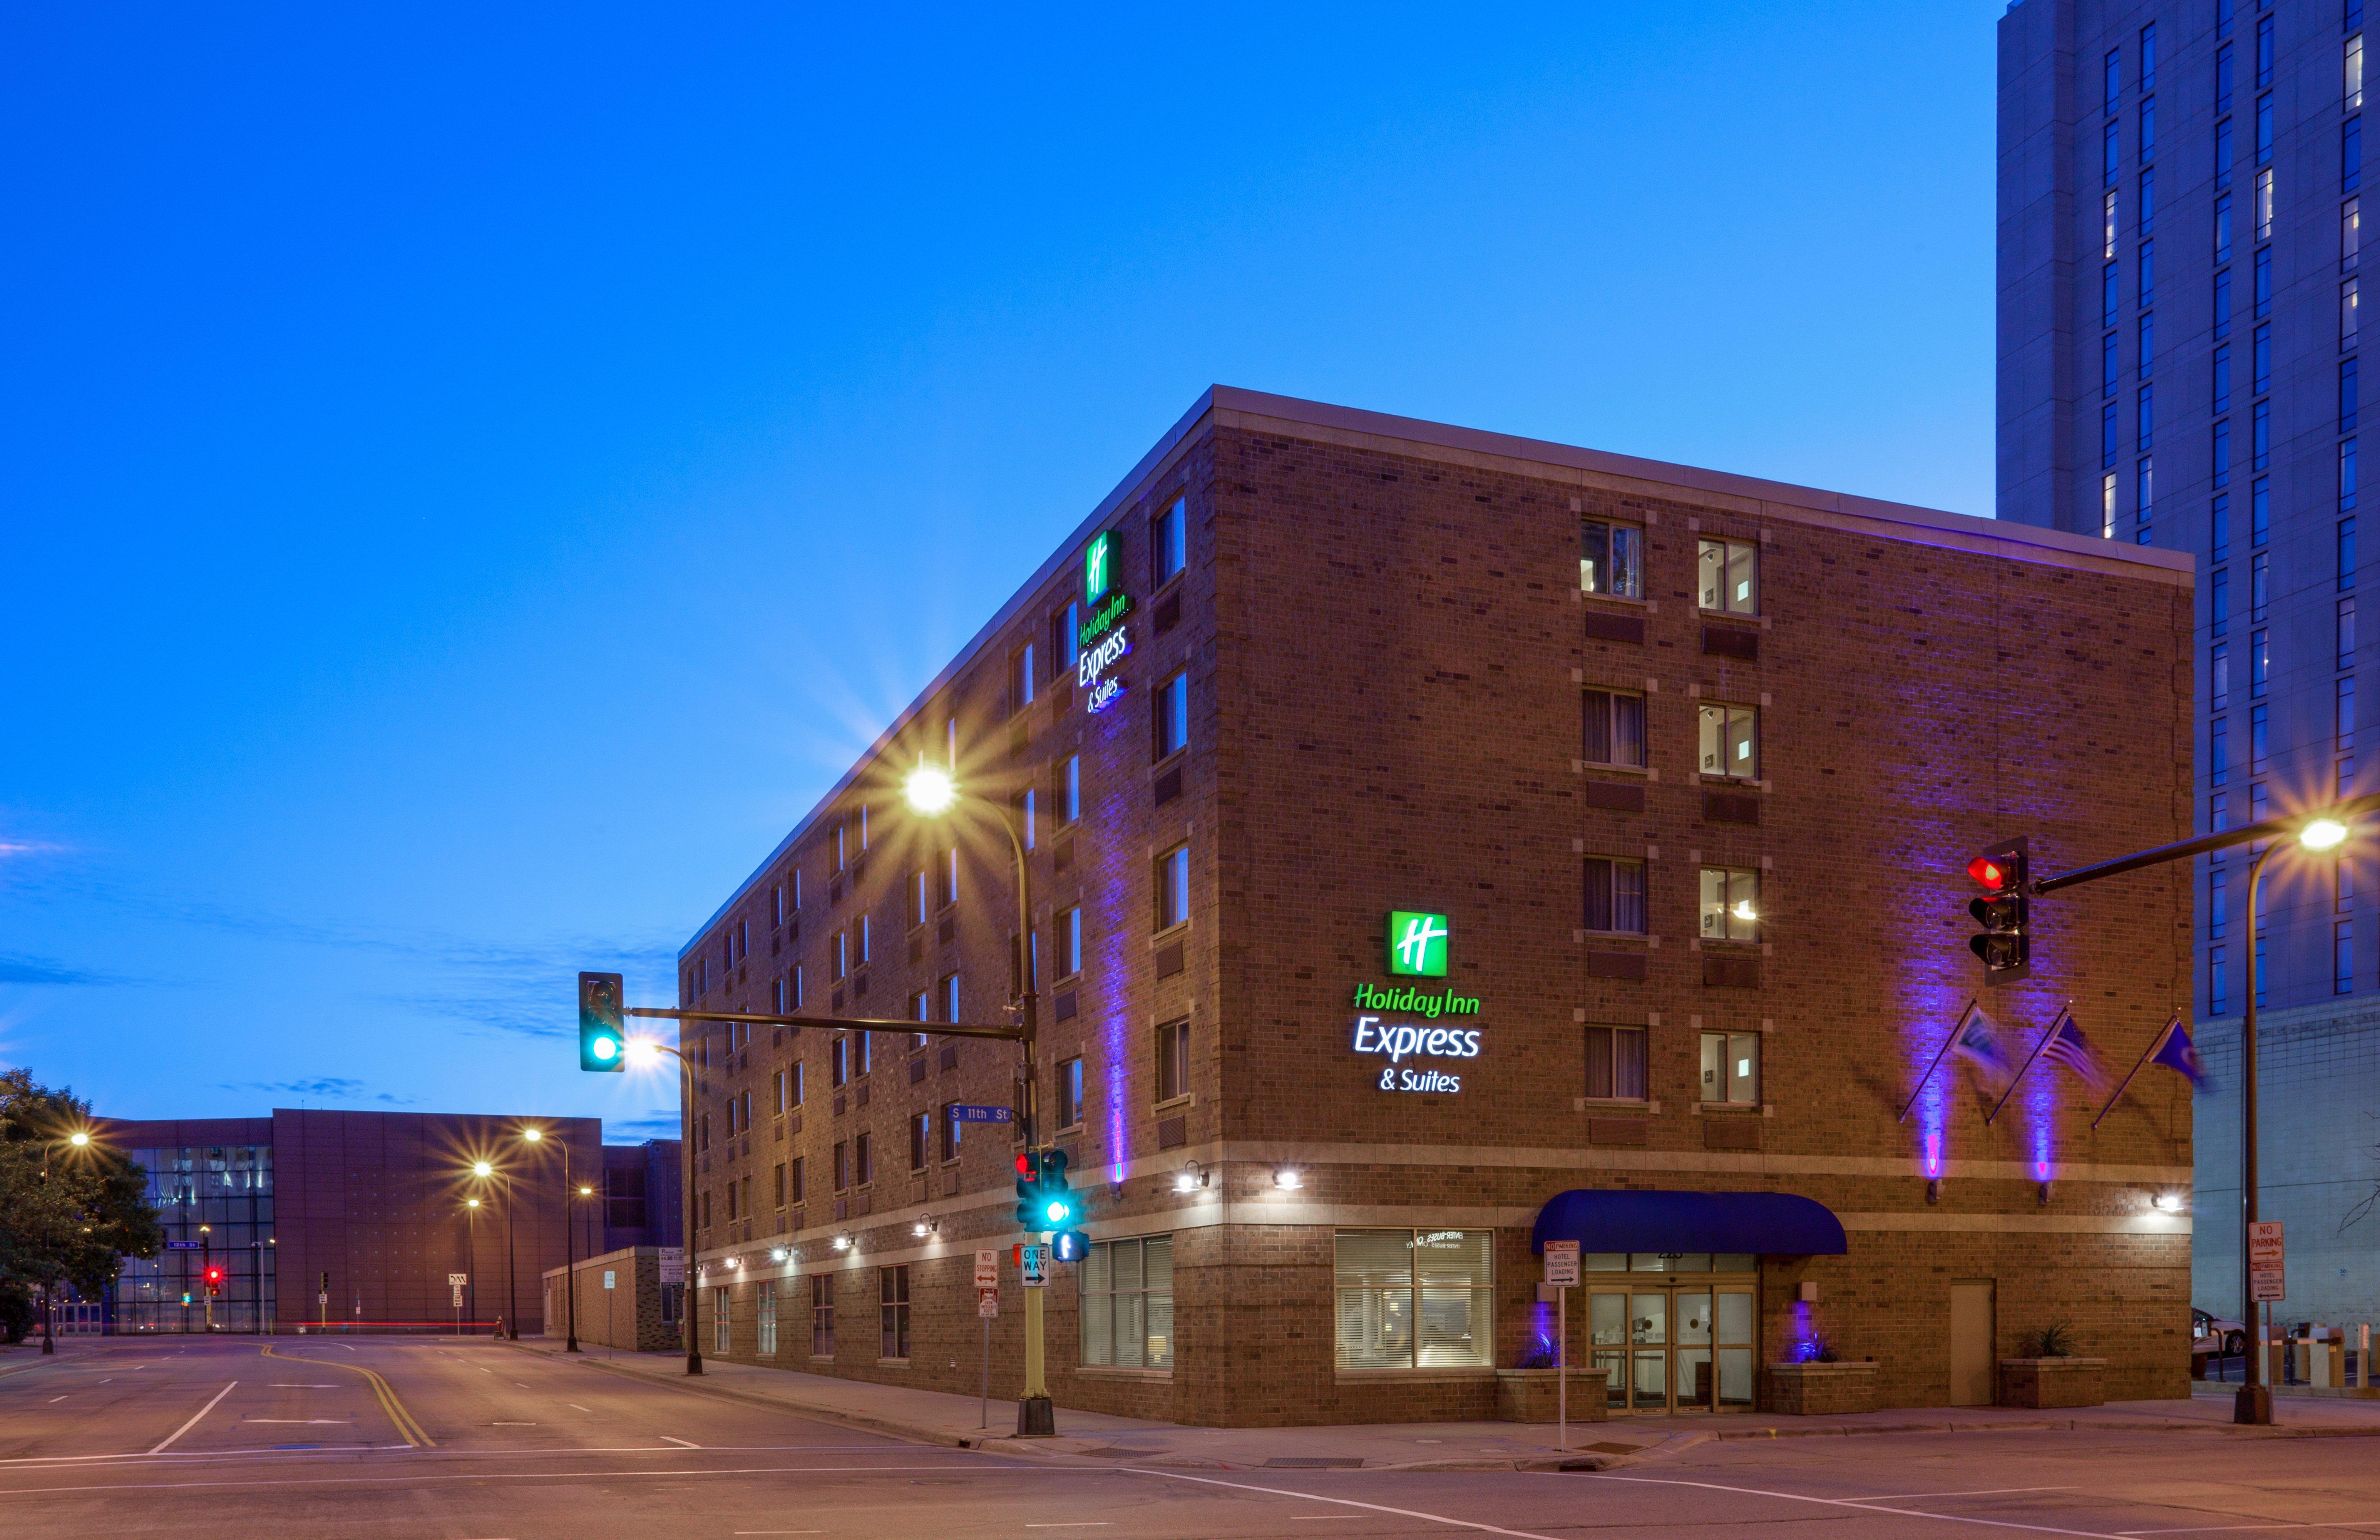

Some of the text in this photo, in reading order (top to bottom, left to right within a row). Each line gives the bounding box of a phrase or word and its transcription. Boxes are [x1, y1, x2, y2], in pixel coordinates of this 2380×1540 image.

[1079, 594, 1125, 648] Holiday Inn
[1079, 626, 1126, 687] Express
[1087, 676, 1118, 713] & Suites
[1354, 983, 1480, 1018] Holiday Inn
[1354, 1016, 1480, 1063] Express
[1380, 1068, 1460, 1093] & Suites
[952, 1108, 1008, 1119] S 11th St
[2259, 1225, 2273, 1235] NO
[2252, 1237, 2282, 1248] PARKING
[982, 1252, 991, 1262] NO
[1024, 1249, 1046, 1259] ONE
[977, 1264, 997, 1272] STOPPING
[1024, 1261, 1047, 1271] WAY
